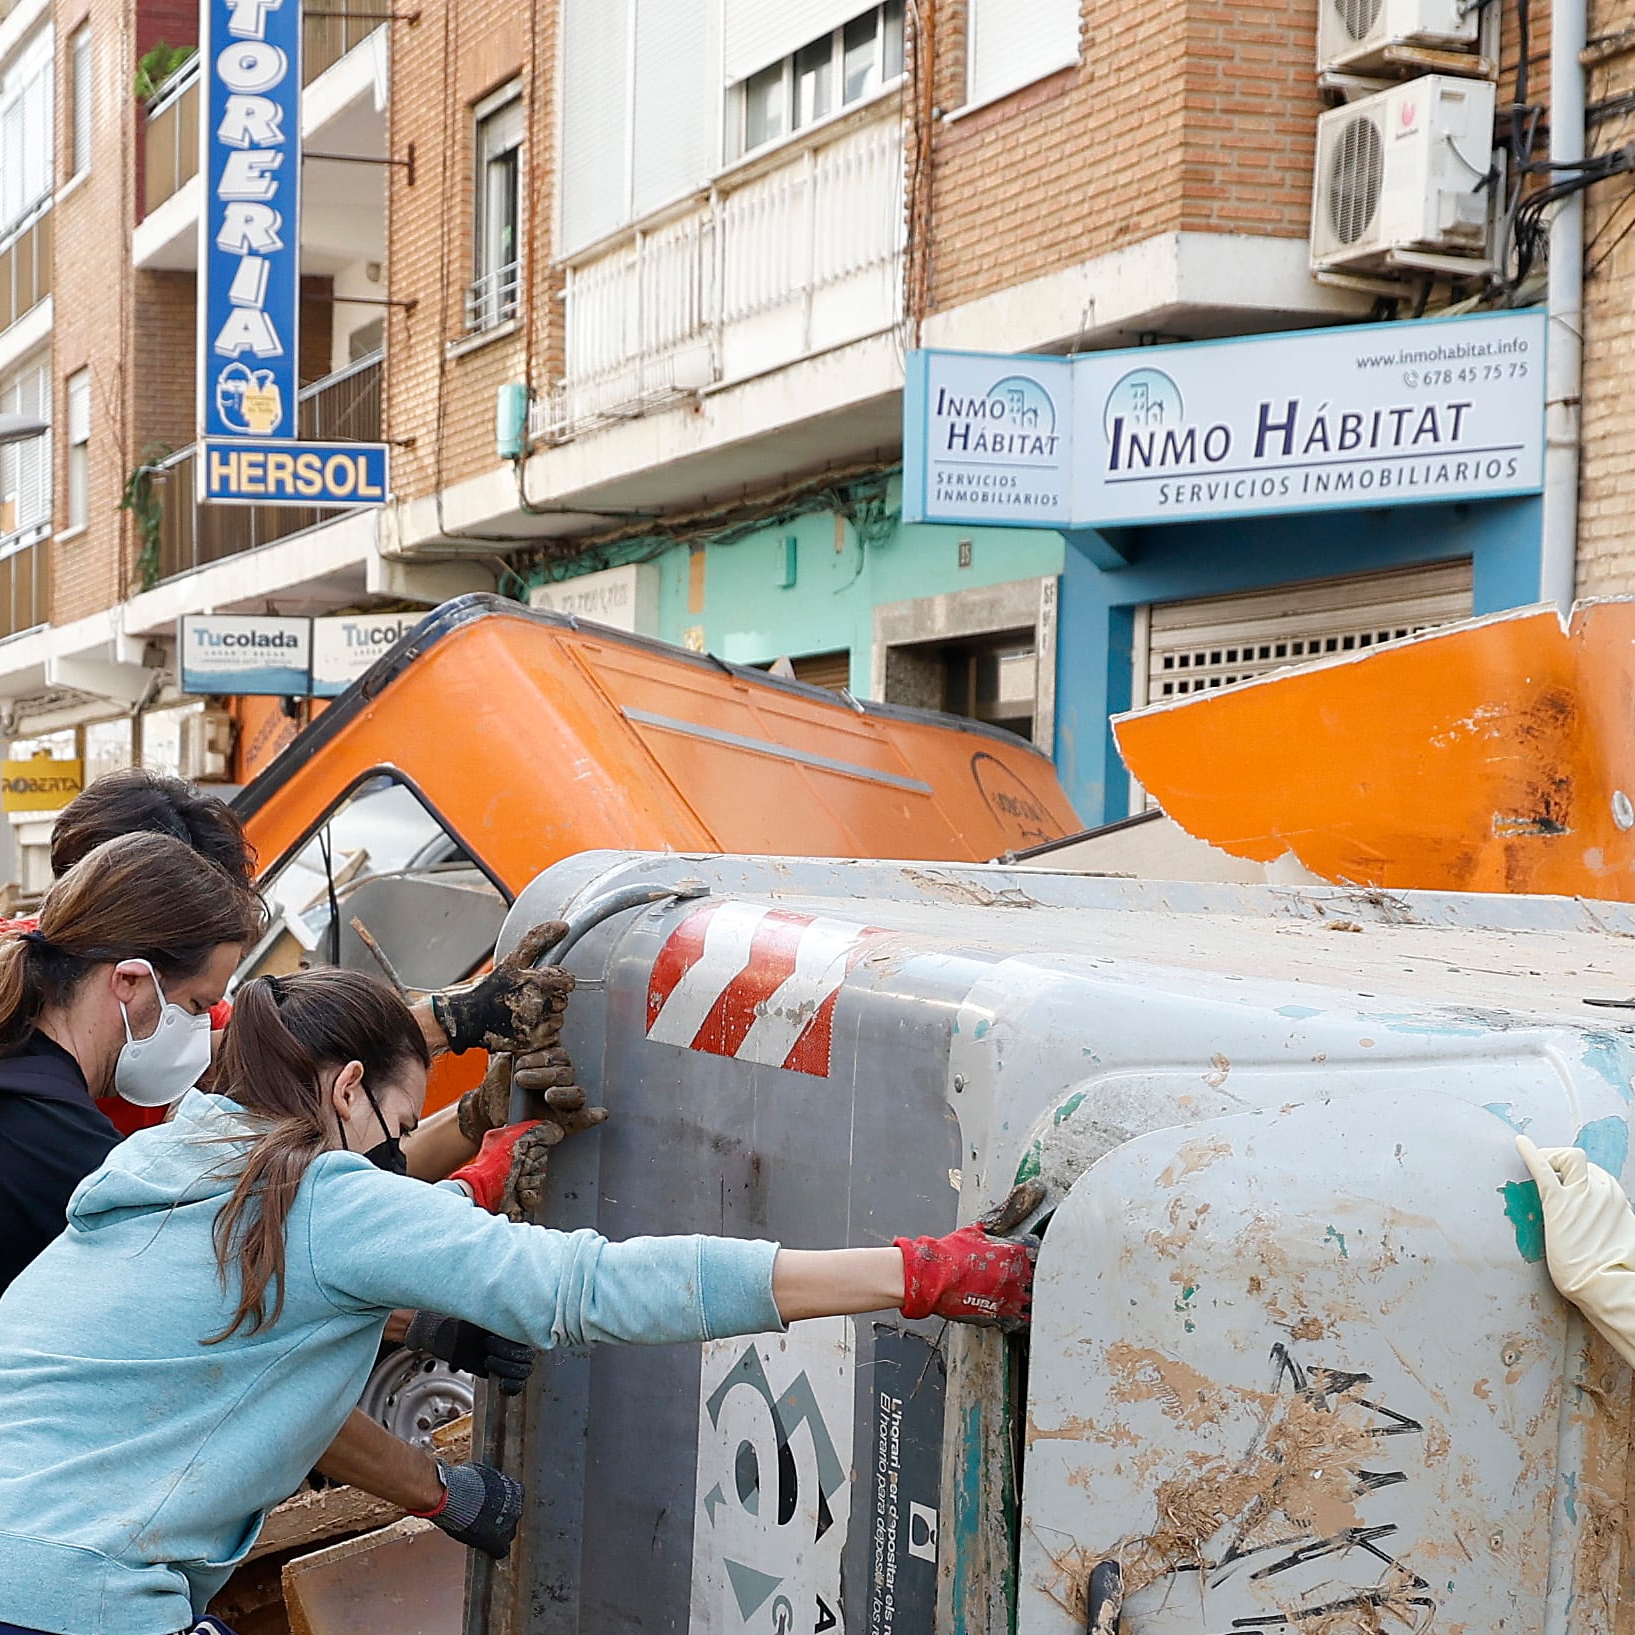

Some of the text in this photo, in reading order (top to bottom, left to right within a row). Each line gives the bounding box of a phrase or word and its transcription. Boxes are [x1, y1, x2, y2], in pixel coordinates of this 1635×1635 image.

[1356, 337, 1529, 368] www.inmohabitat.info
[1423, 361, 1529, 386] 678 45 75 75
[210, 452, 381, 497] HERSOL
[193, 628, 298, 648] Tucolada
[880, 1391, 891, 1413] El
[878, 1413, 890, 1472] horario
[890, 1398, 903, 1469] L'horari
[876, 1472, 887, 1514] para
[884, 1594, 895, 1621] els
